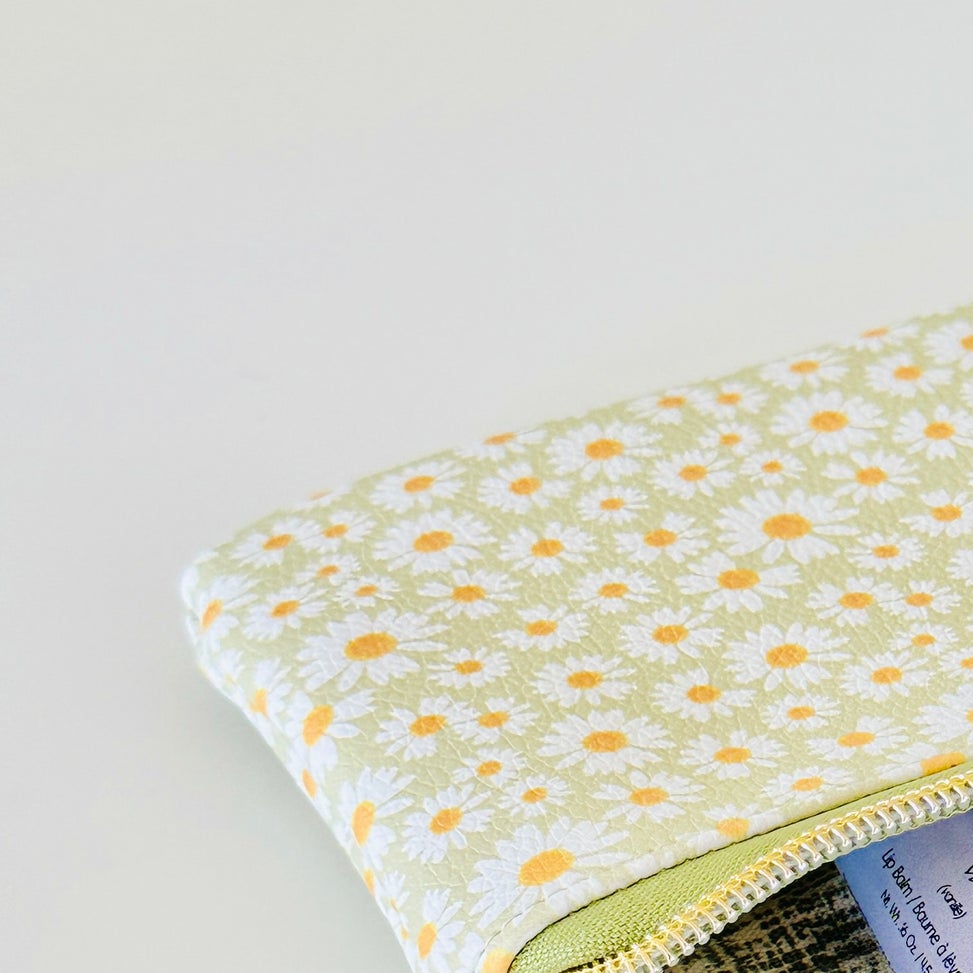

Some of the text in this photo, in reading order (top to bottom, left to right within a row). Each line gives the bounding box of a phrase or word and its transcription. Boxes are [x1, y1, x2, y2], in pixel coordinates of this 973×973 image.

[880, 848, 897, 868] Lip
[892, 866, 913, 898] Balm
[912, 902, 940, 945] Baume
[937, 943, 948, 956] à
